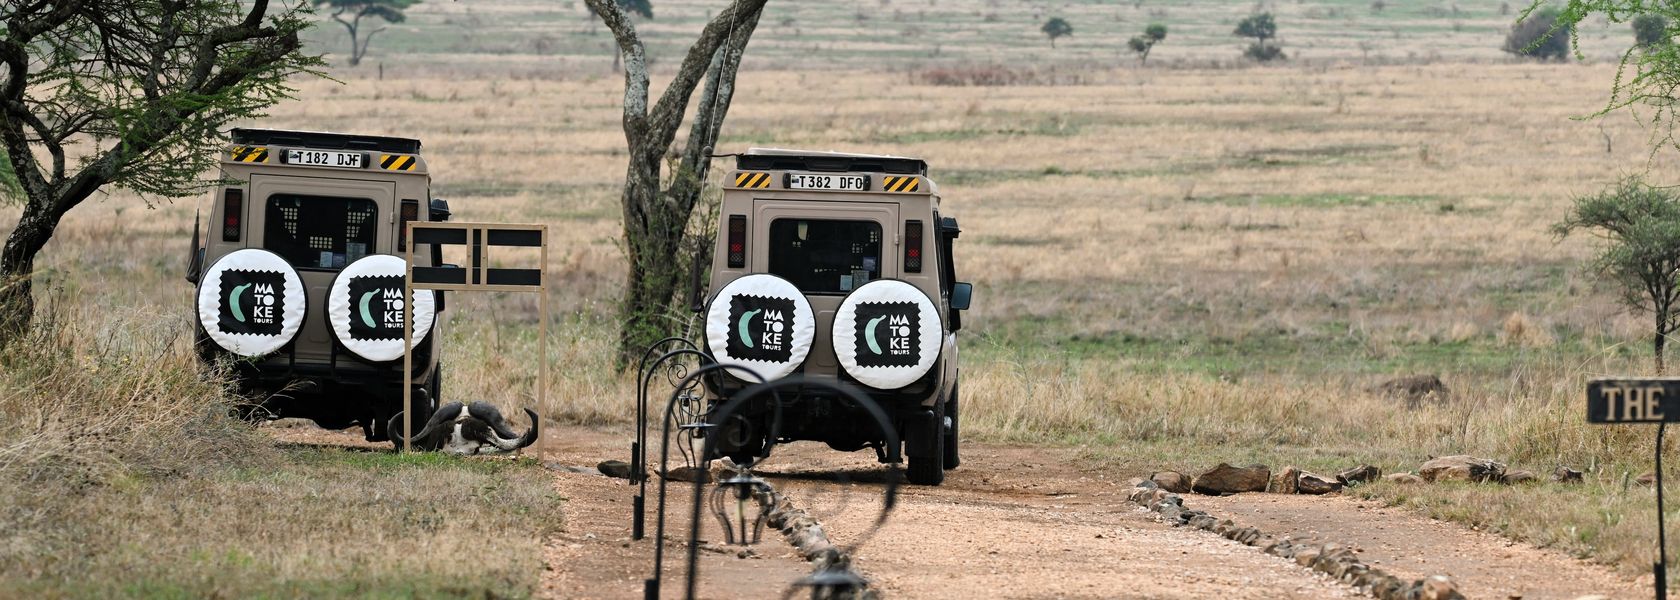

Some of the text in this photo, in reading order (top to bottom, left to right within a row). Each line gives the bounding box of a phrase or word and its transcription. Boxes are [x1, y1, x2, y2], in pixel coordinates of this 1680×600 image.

[337, 153, 360, 166] DJF
[254, 283, 275, 295] MA
[383, 288, 404, 299] MA
[254, 294, 275, 306] TO
[383, 299, 404, 311] TO
[253, 306, 274, 318] KE
[384, 311, 404, 323] KE
[763, 309, 784, 321] MA
[889, 314, 910, 325] MA
[763, 320, 784, 333] TO
[889, 326, 911, 337] TO
[762, 332, 783, 345] KE
[890, 338, 910, 349] KE
[1600, 386, 1665, 421] THE
